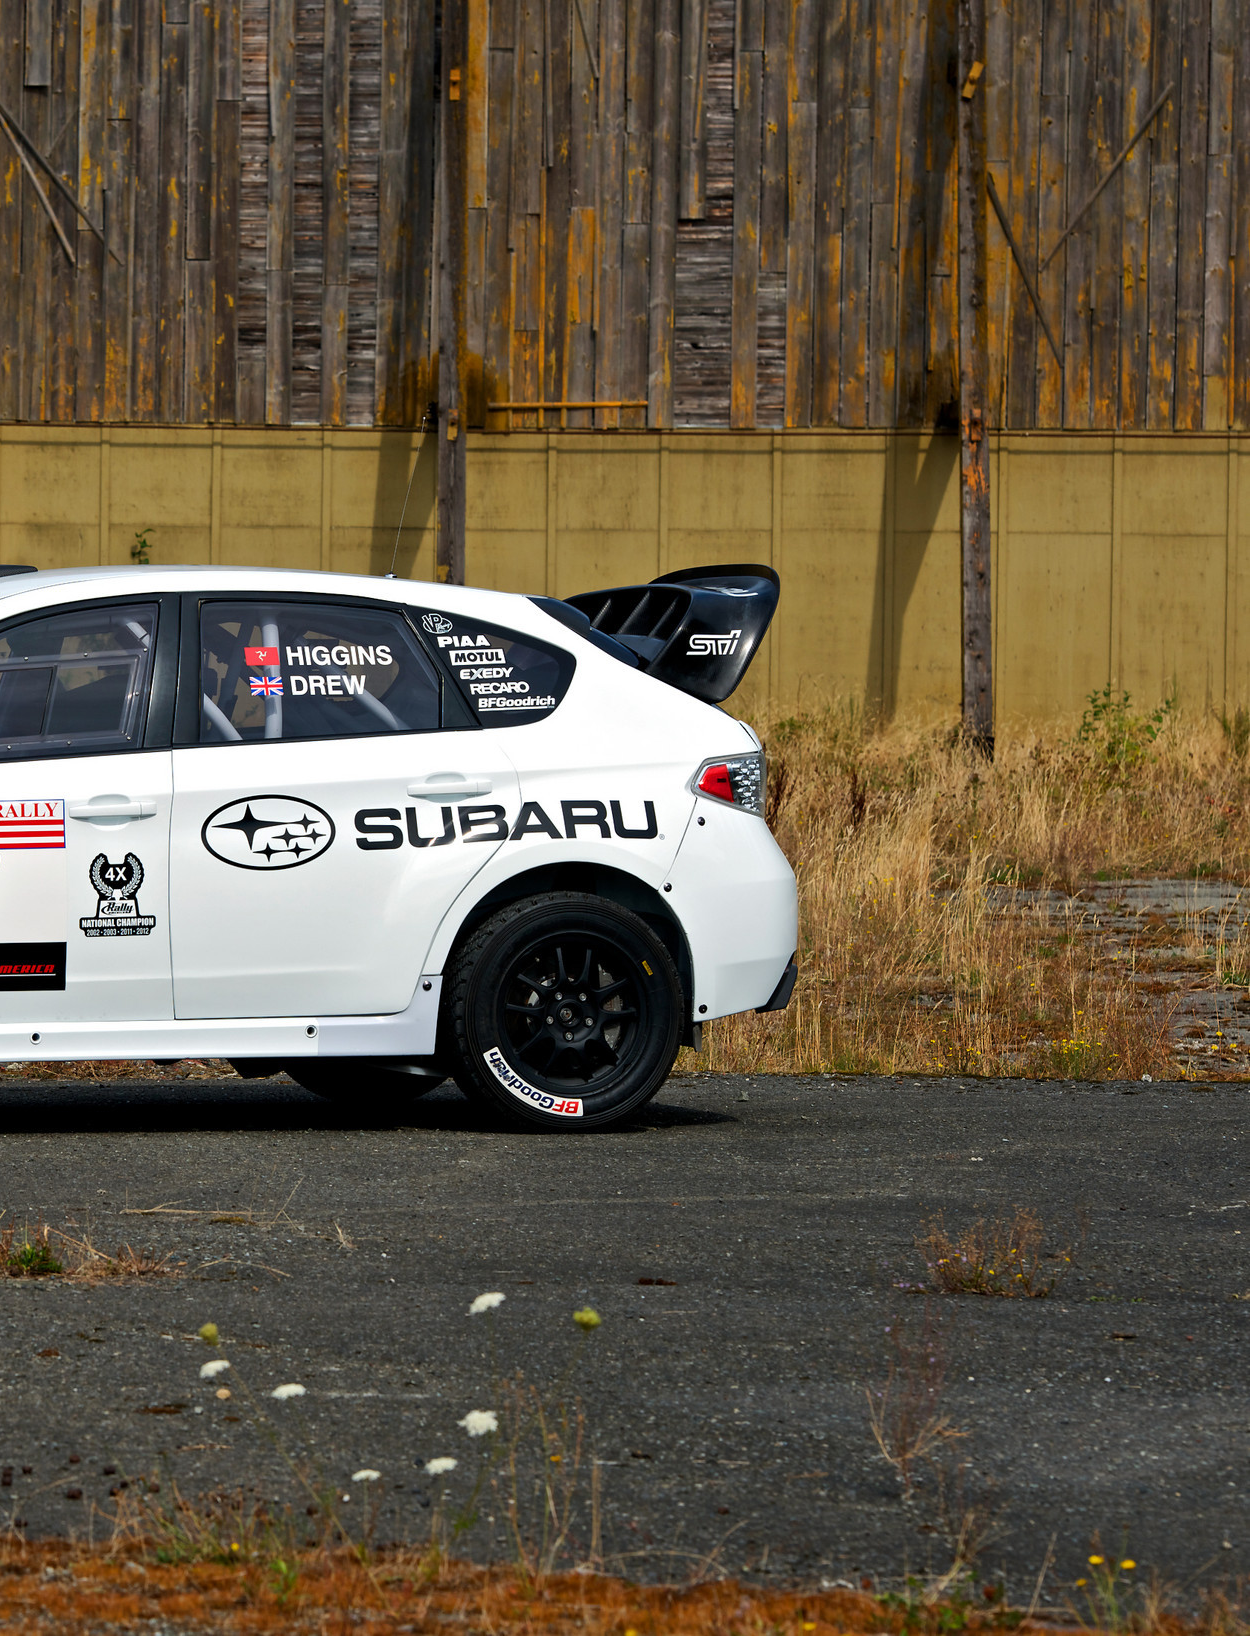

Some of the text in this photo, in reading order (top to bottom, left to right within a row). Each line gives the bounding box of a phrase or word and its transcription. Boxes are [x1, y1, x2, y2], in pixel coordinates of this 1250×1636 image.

[437, 635, 490, 648] PIAA
[285, 645, 393, 667] HIGGINS
[454, 651, 503, 663] MOTUL
[459, 667, 513, 680] EXEDY
[289, 675, 367, 696] DREW
[470, 681, 530, 695] RECARO
[478, 695, 556, 708] BFGoodrich
[354, 800, 658, 851] SUBARU
[105, 867, 127, 881] 4X
[107, 902, 134, 913] Rally
[81, 917, 154, 928] NATIONAL CHAMPION
[136, 927, 150, 935] 2012
